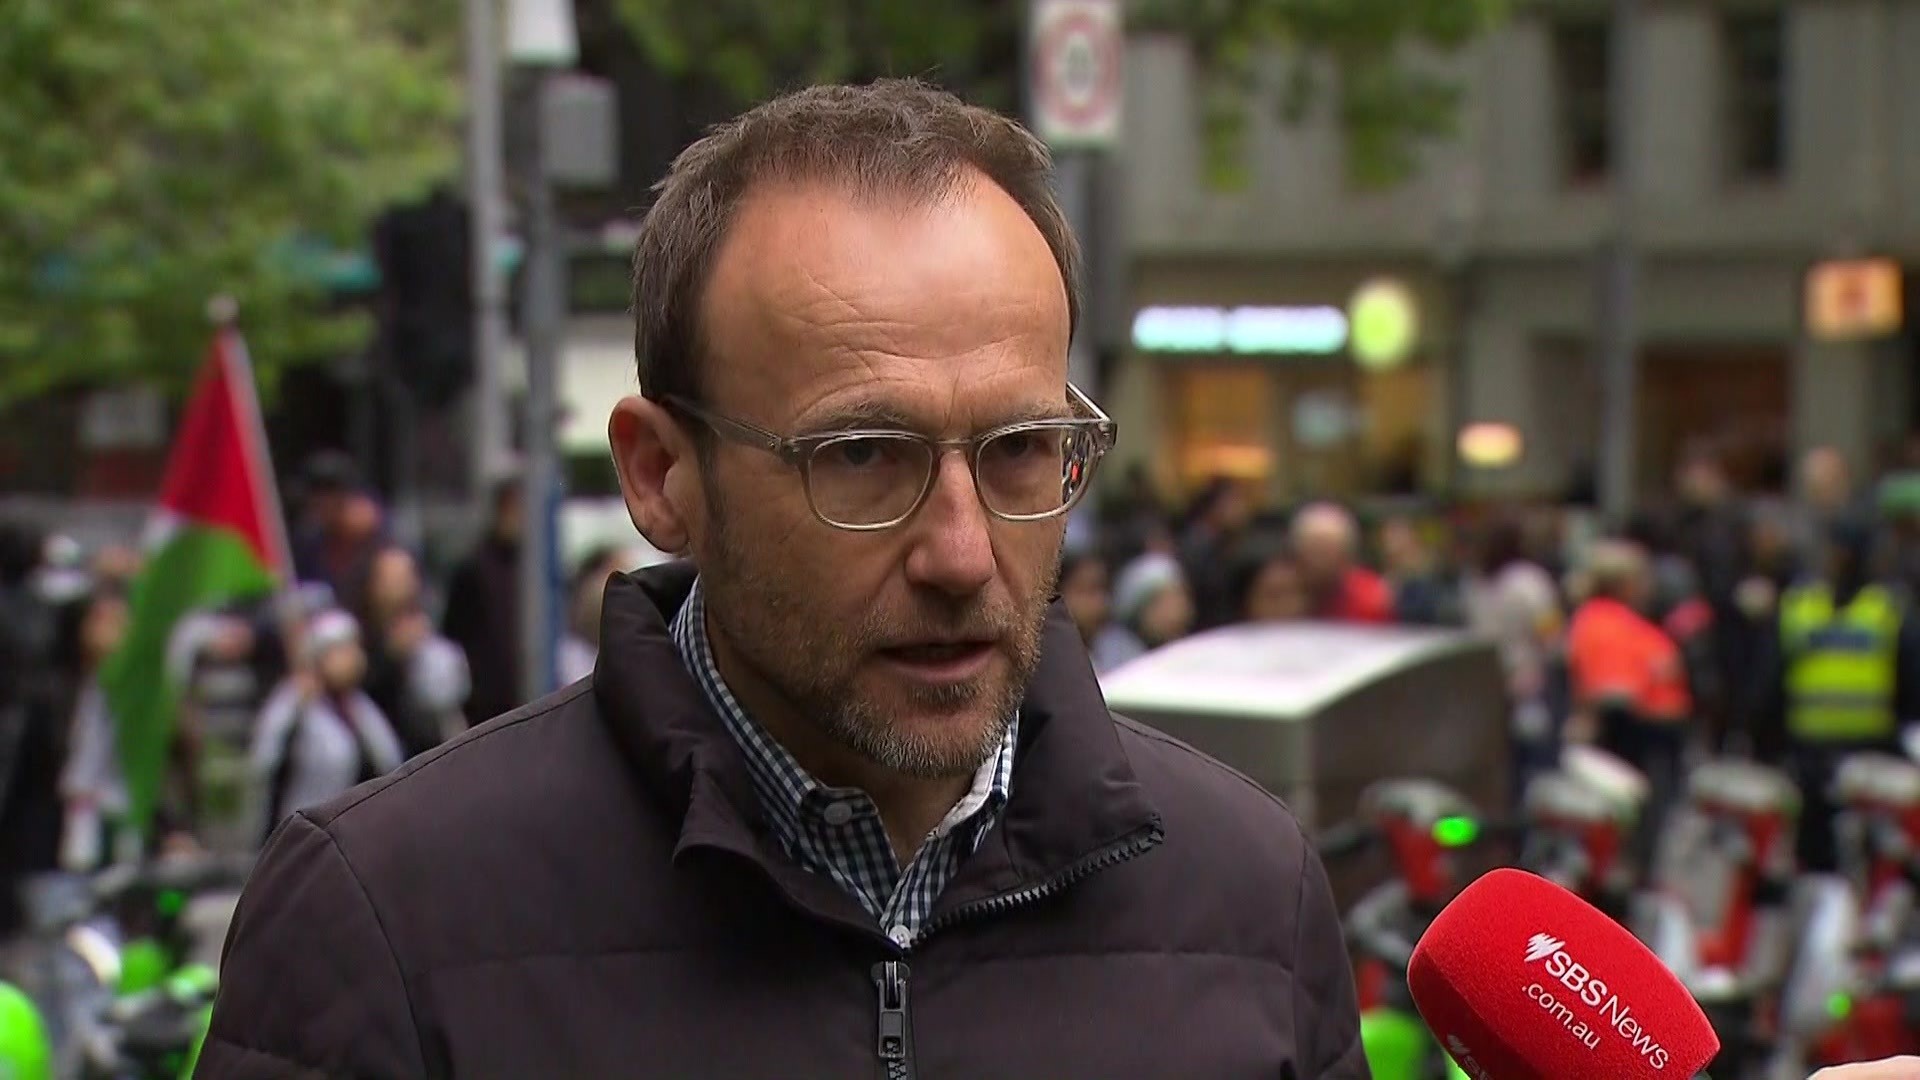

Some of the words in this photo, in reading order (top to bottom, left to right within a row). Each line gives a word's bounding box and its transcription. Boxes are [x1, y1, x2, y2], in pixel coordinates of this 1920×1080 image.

[1522, 982, 1600, 1050] .com.au
[1546, 951, 1608, 1007] SBS
[1600, 995, 1669, 1070] News
